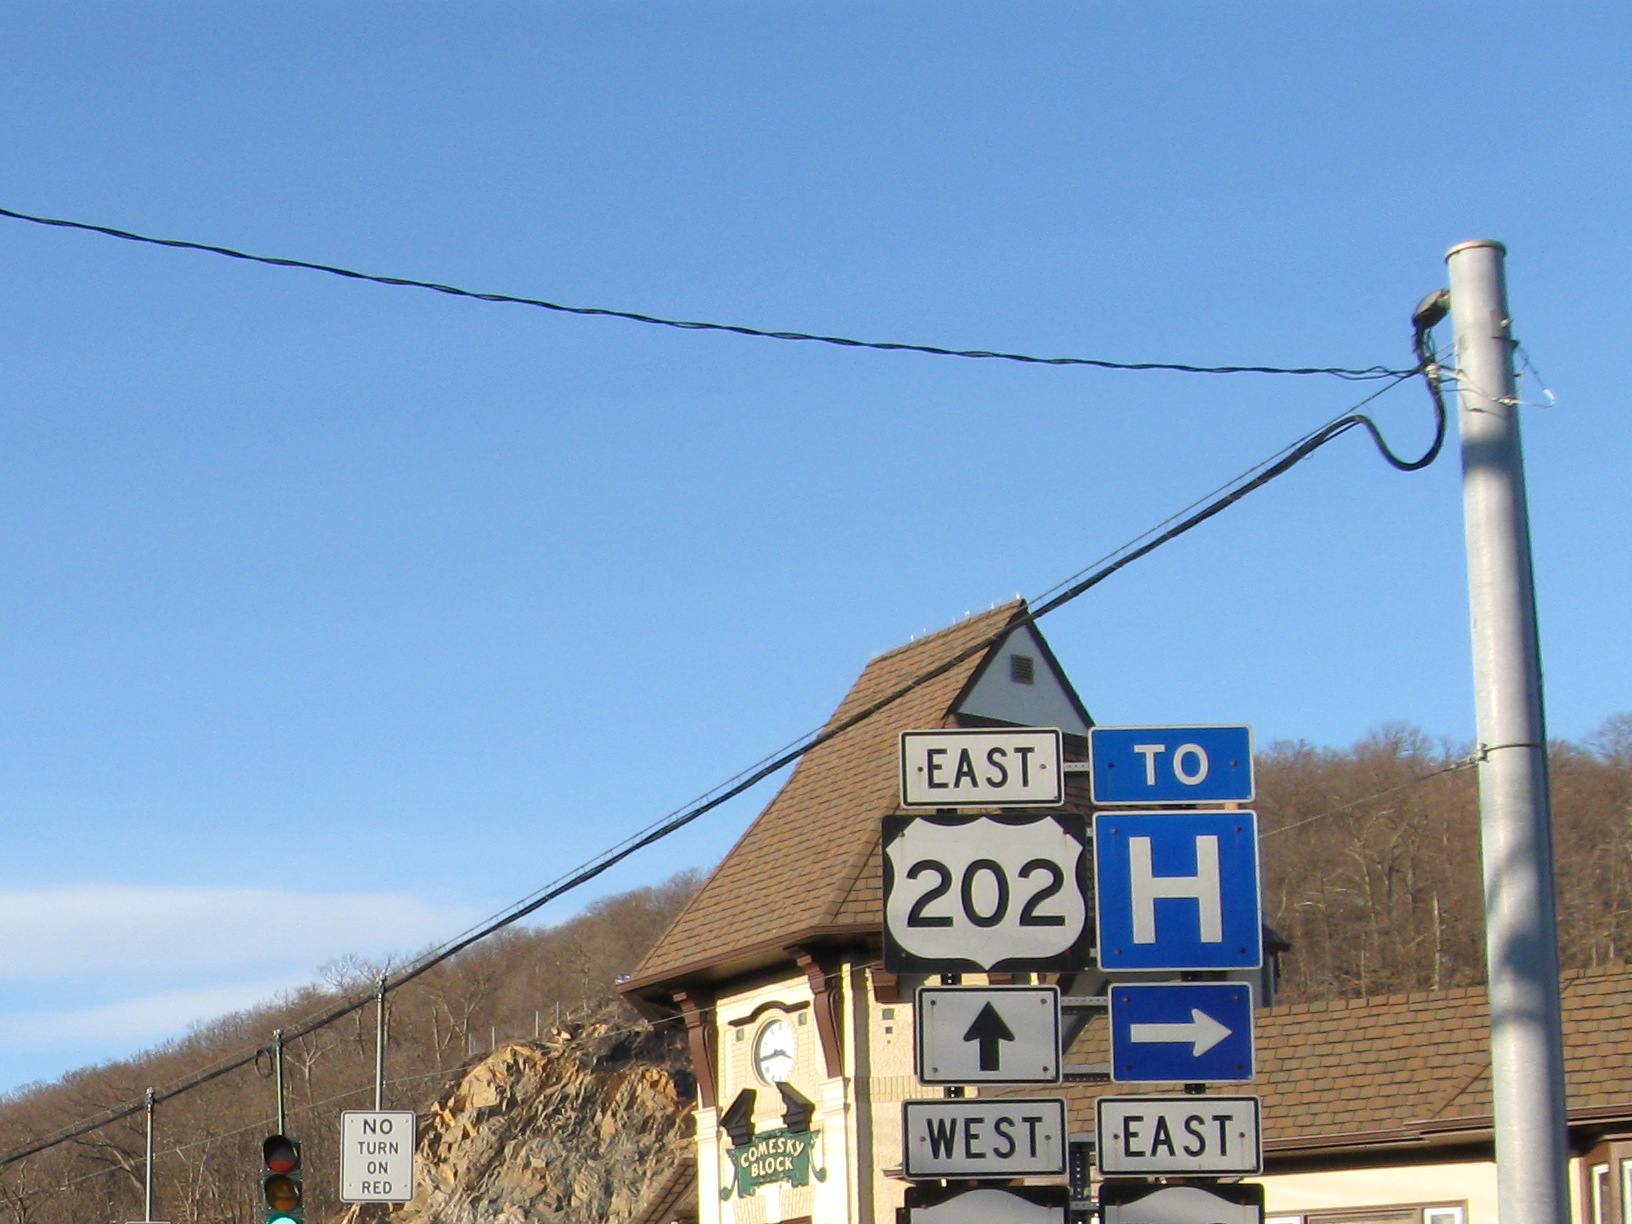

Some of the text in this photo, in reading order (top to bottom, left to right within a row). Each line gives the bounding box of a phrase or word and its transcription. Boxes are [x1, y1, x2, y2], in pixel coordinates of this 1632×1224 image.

[926, 746, 1036, 789] EAST
[1133, 743, 1209, 786] TO
[905, 858, 1067, 929] 202
[1128, 835, 1223, 944] H
[363, 1118, 394, 1136] NO
[925, 1116, 1044, 1160] WEST
[1122, 1114, 1234, 1158] EAST
[357, 1141, 399, 1155] TURN
[740, 1137, 805, 1169] COMESKY
[366, 1160, 389, 1175] ON
[750, 1155, 794, 1179] BLOCK
[361, 1180, 393, 1195] RED
